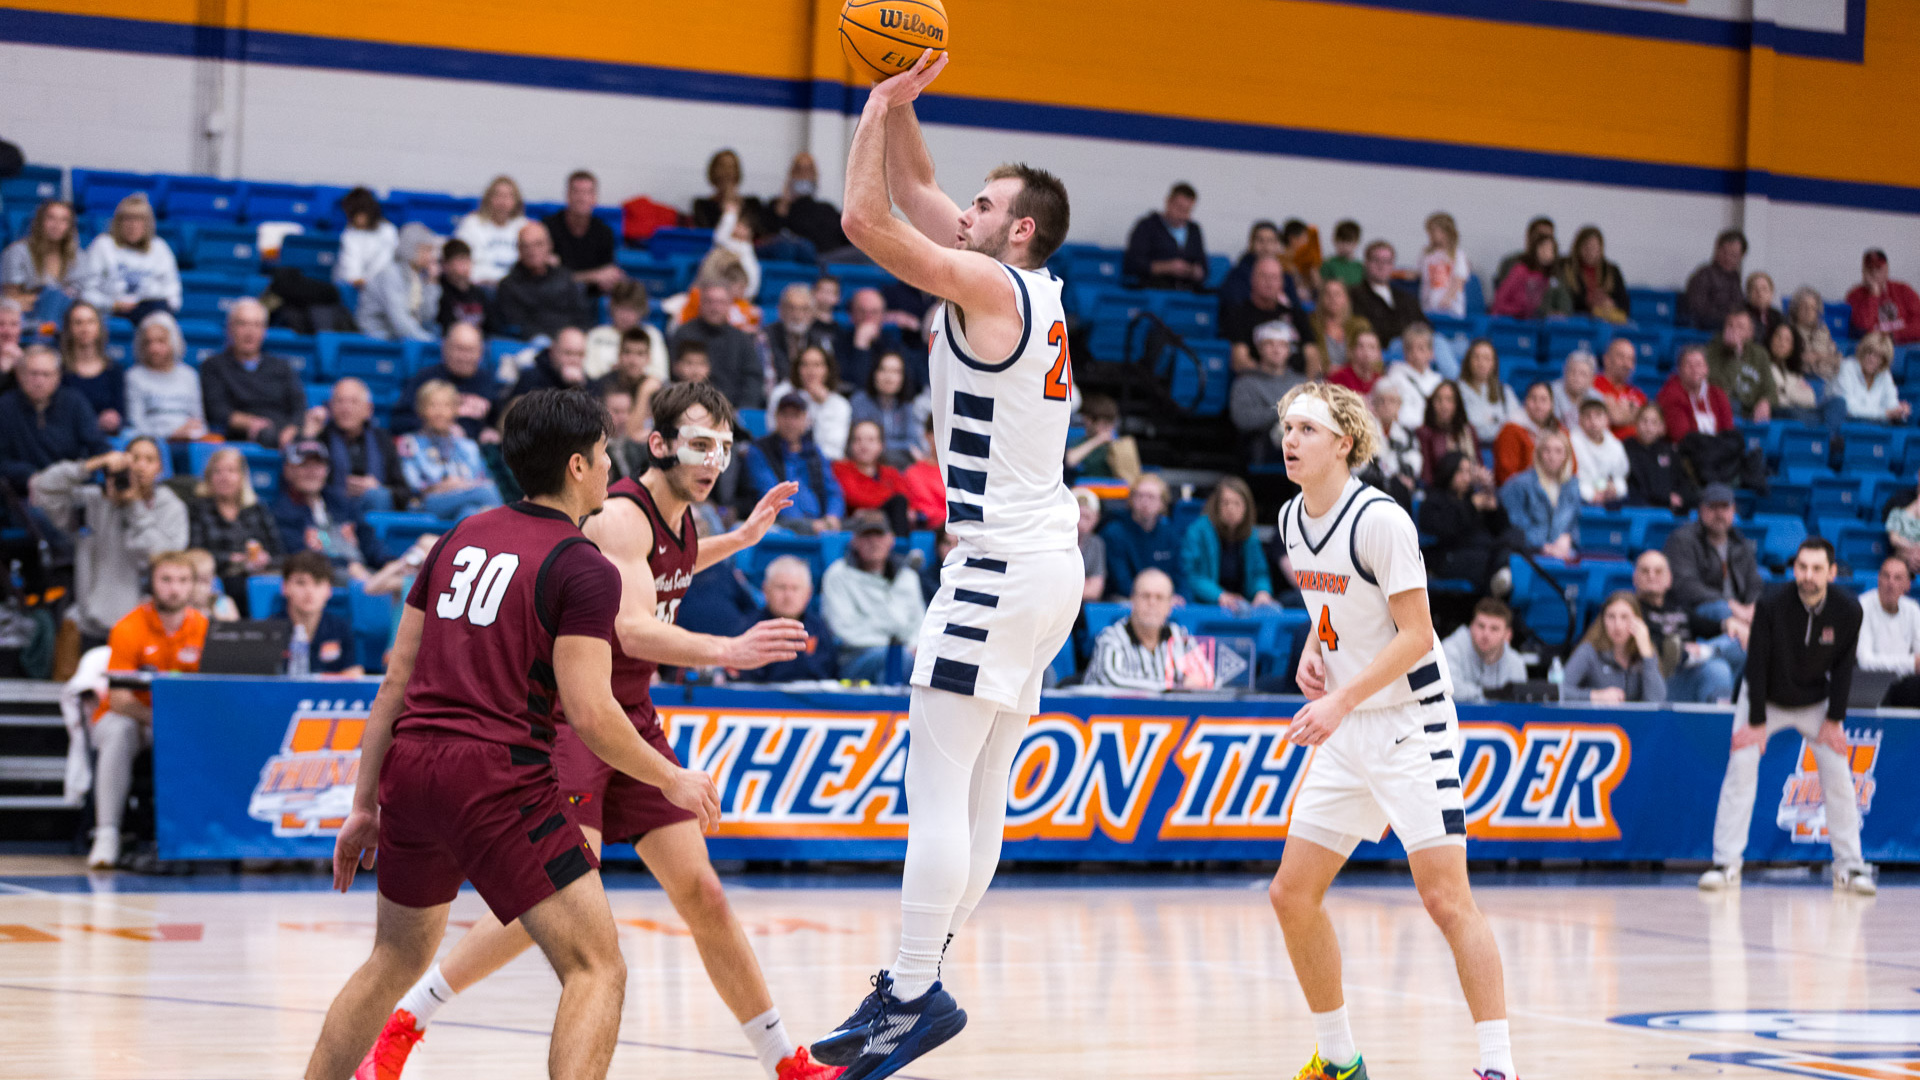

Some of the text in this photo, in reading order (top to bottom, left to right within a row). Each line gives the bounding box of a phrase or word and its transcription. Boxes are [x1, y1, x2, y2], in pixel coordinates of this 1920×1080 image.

[879, 8, 944, 42] Wilson
[881, 51, 919, 72] EV
[1043, 320, 1073, 402] 2
[436, 545, 520, 627] 30
[1318, 603, 1340, 652] 4
[656, 711, 1619, 828] HEAON THDER
